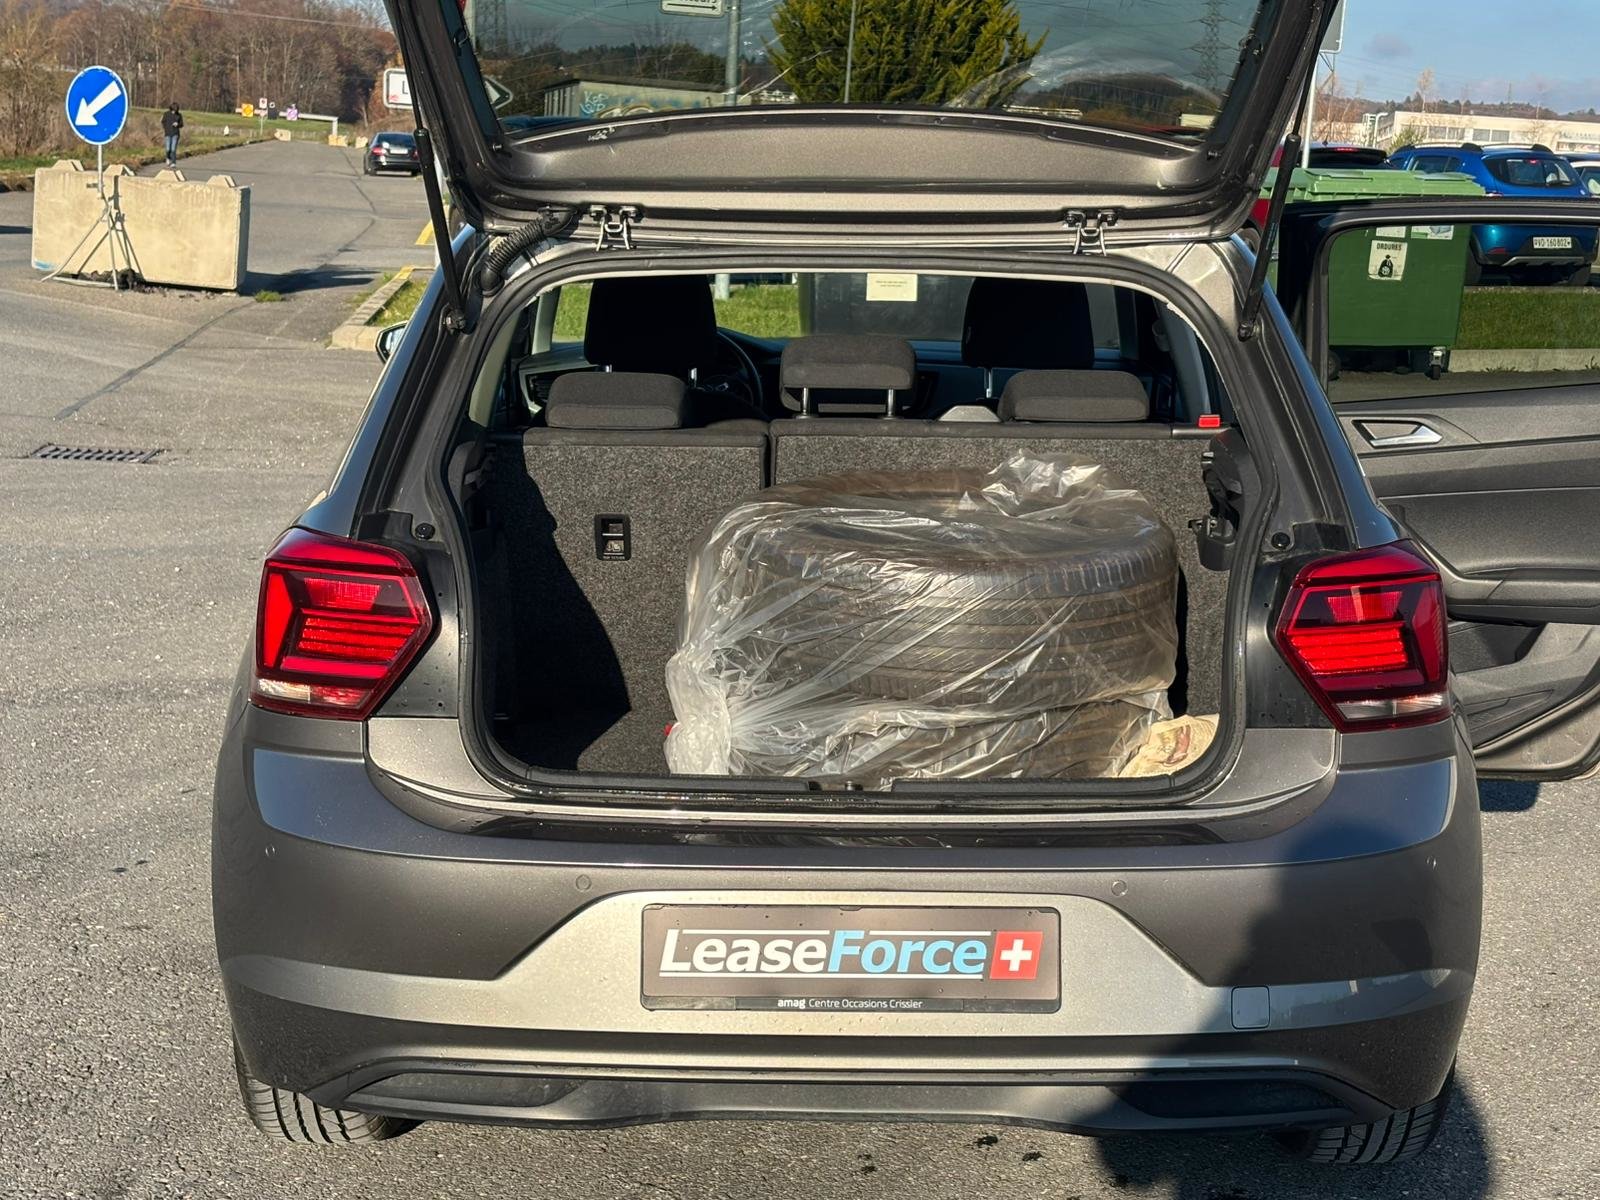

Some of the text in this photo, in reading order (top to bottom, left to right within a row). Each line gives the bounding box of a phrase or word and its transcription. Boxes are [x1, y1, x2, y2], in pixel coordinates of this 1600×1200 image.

[1376, 243, 1402, 251] ORDURES
[659, 928, 987, 974] LeaseForce
[777, 998, 923, 1010] amag Centre Occasions Crissier
